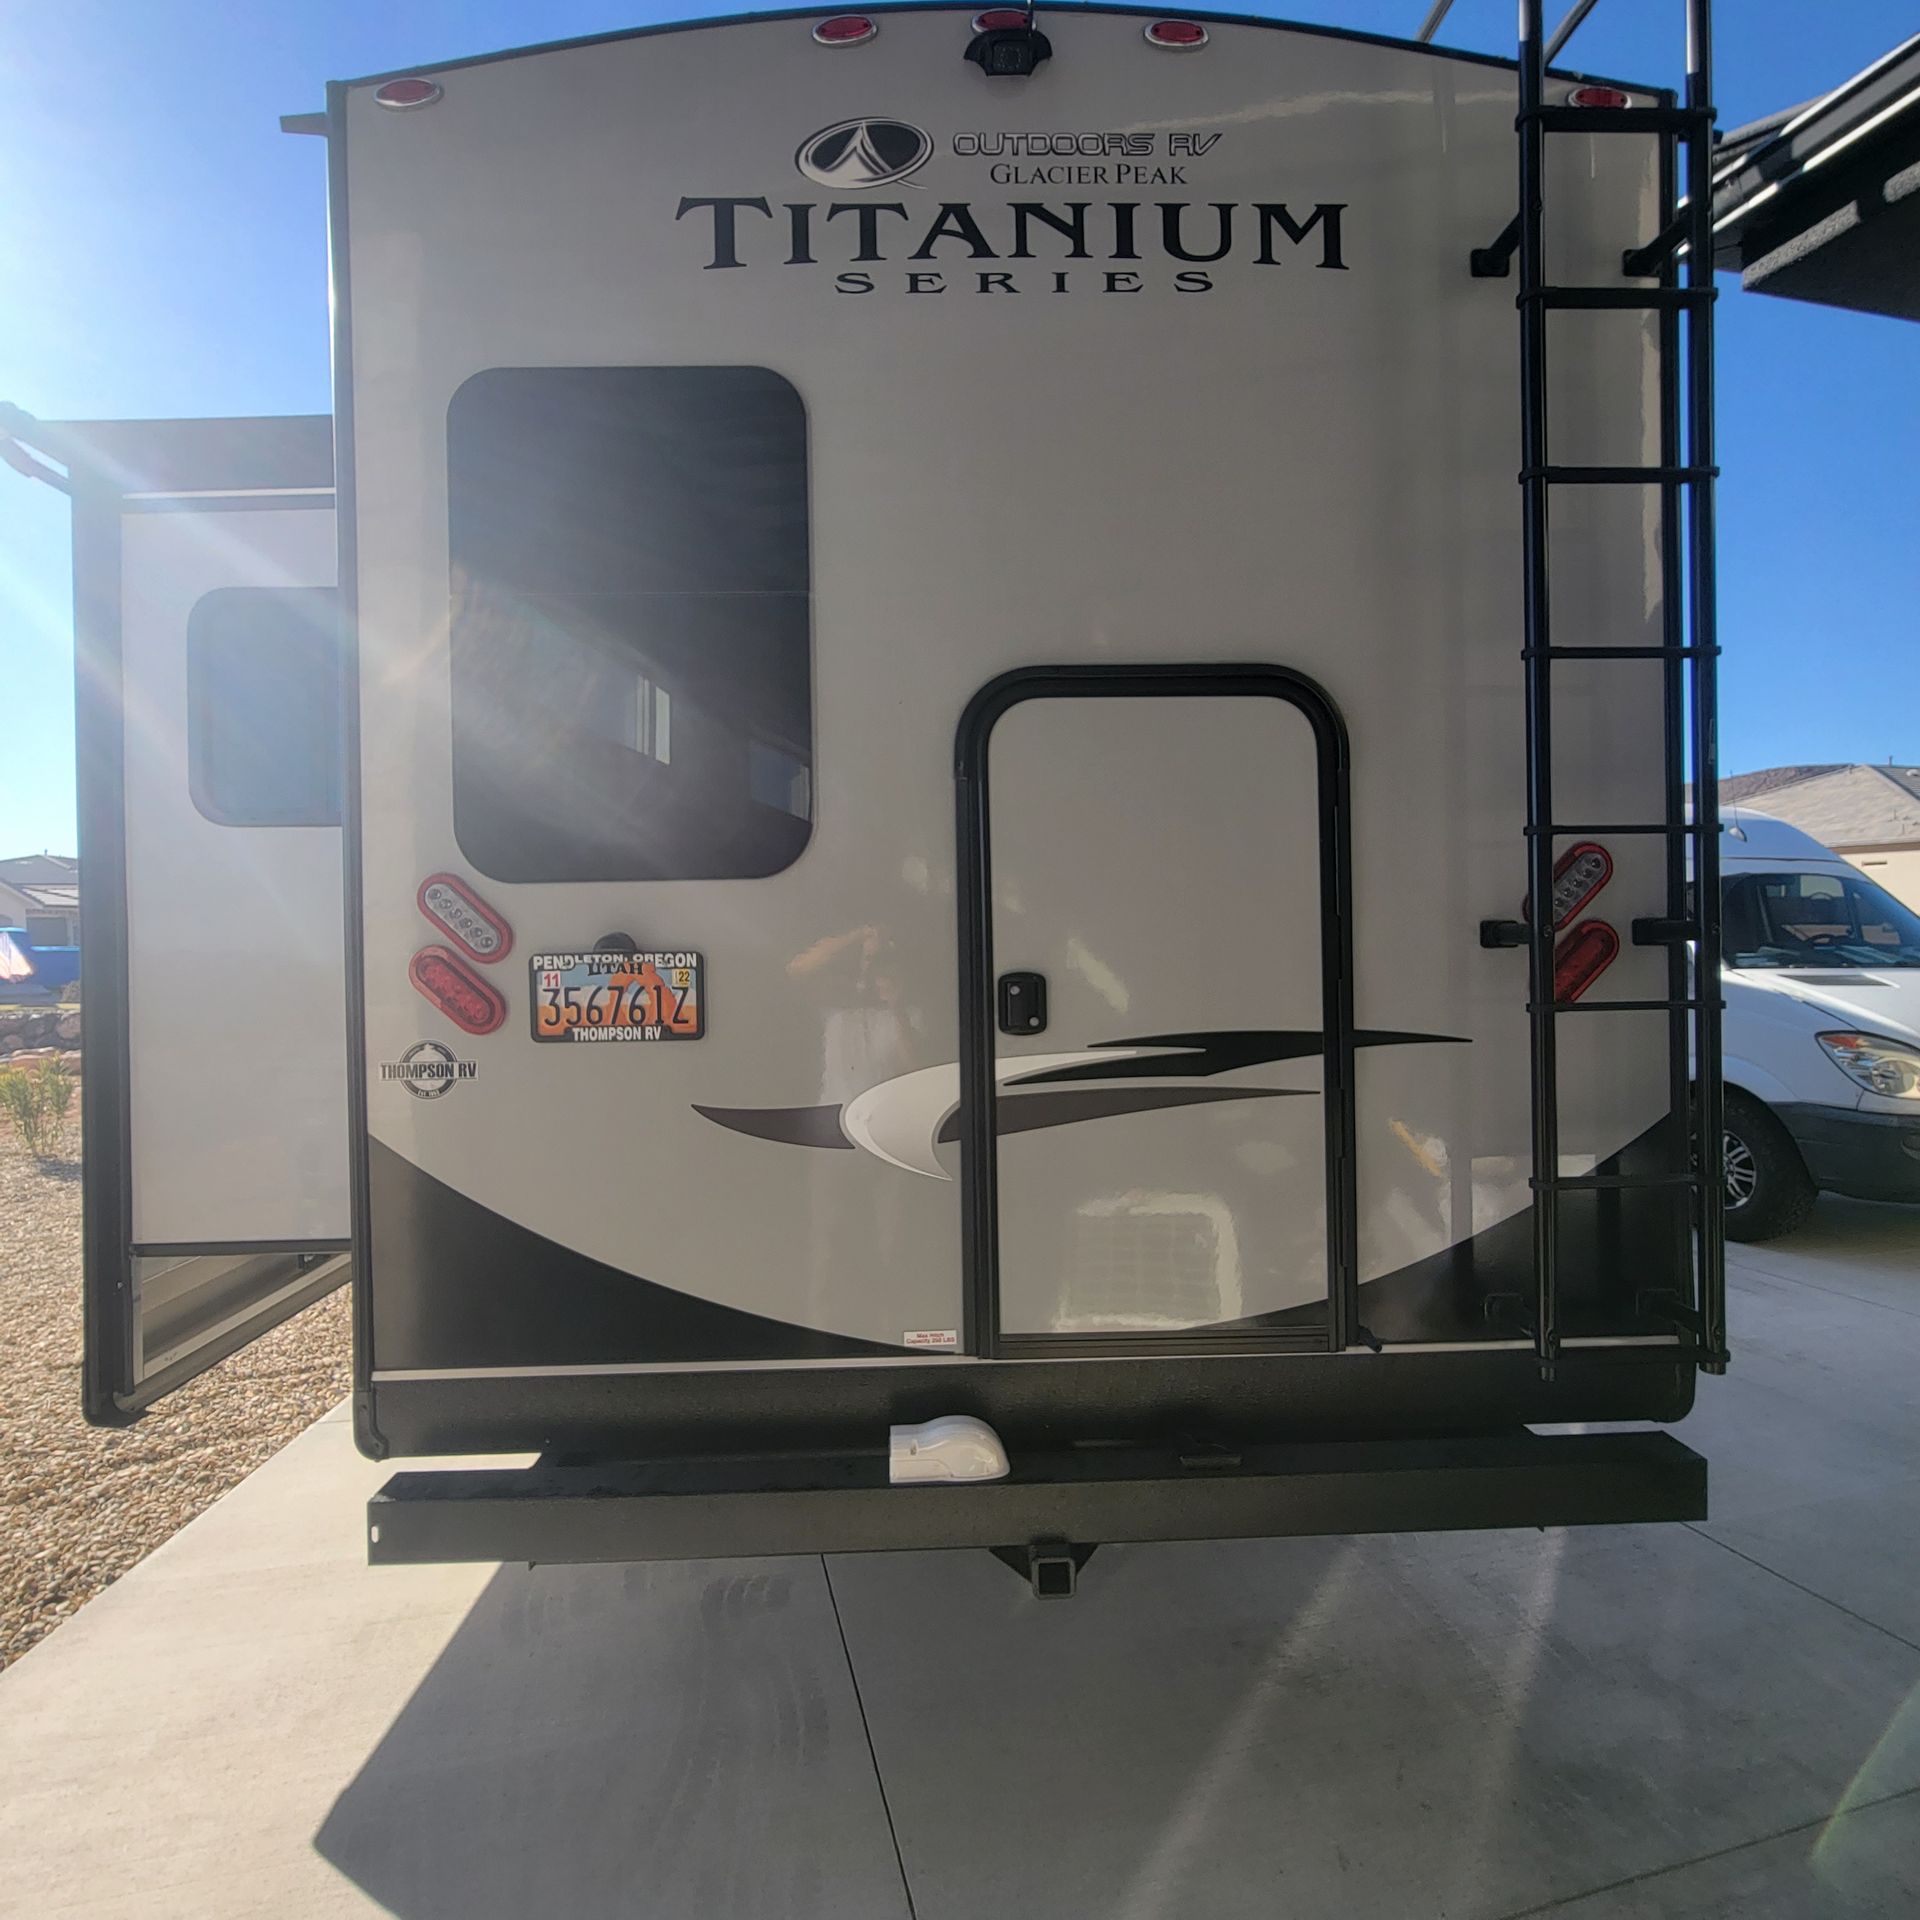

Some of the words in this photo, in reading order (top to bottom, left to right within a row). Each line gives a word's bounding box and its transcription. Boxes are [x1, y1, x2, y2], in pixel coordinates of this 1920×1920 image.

[953, 132, 1156, 157] OUTDOORS
[1168, 132, 1223, 157] RV
[990, 163, 1110, 185] GLACIER
[1116, 163, 1188, 185] PEAK
[675, 196, 1350, 270] TITANIUM
[834, 271, 1214, 294] SERIES
[632, 952, 698, 968] OREGON
[587, 963, 643, 976] UTAH
[543, 972, 560, 988] 11
[572, 1026, 642, 1042] THOMPSON
[644, 1025, 662, 1040] RV
[381, 1063, 455, 1079] THOMPSON
[458, 1061, 477, 1078] RV
